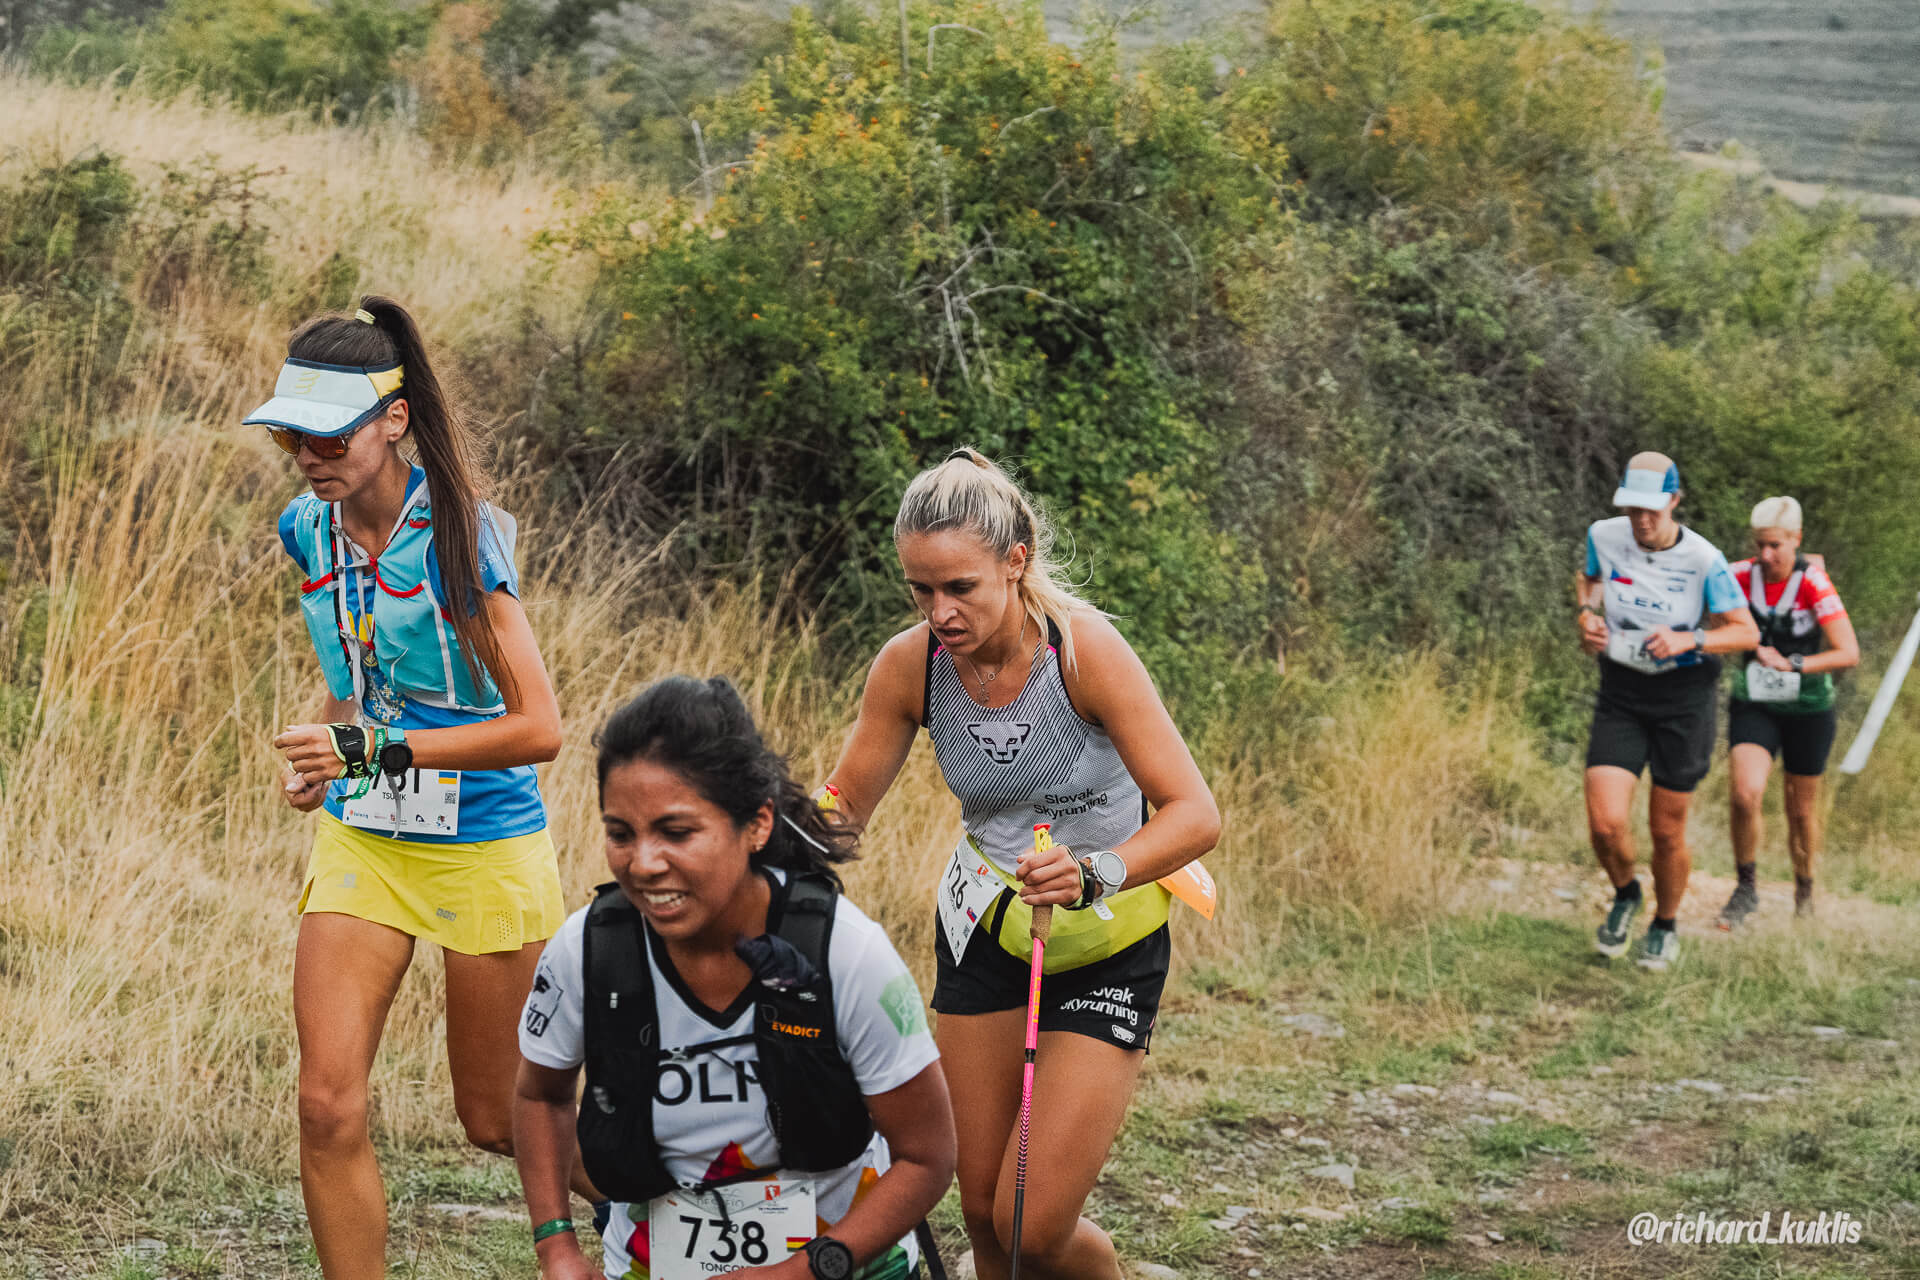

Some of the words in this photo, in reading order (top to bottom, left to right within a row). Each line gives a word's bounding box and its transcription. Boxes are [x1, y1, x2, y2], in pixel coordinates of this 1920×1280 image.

[1618, 593, 1672, 613] LEKI
[1034, 792, 1108, 820] Skyrunning
[1045, 787, 1094, 804] Slovak
[947, 849, 968, 910] 726
[771, 1021, 822, 1039] EVADICT
[679, 1214, 769, 1265] 738
